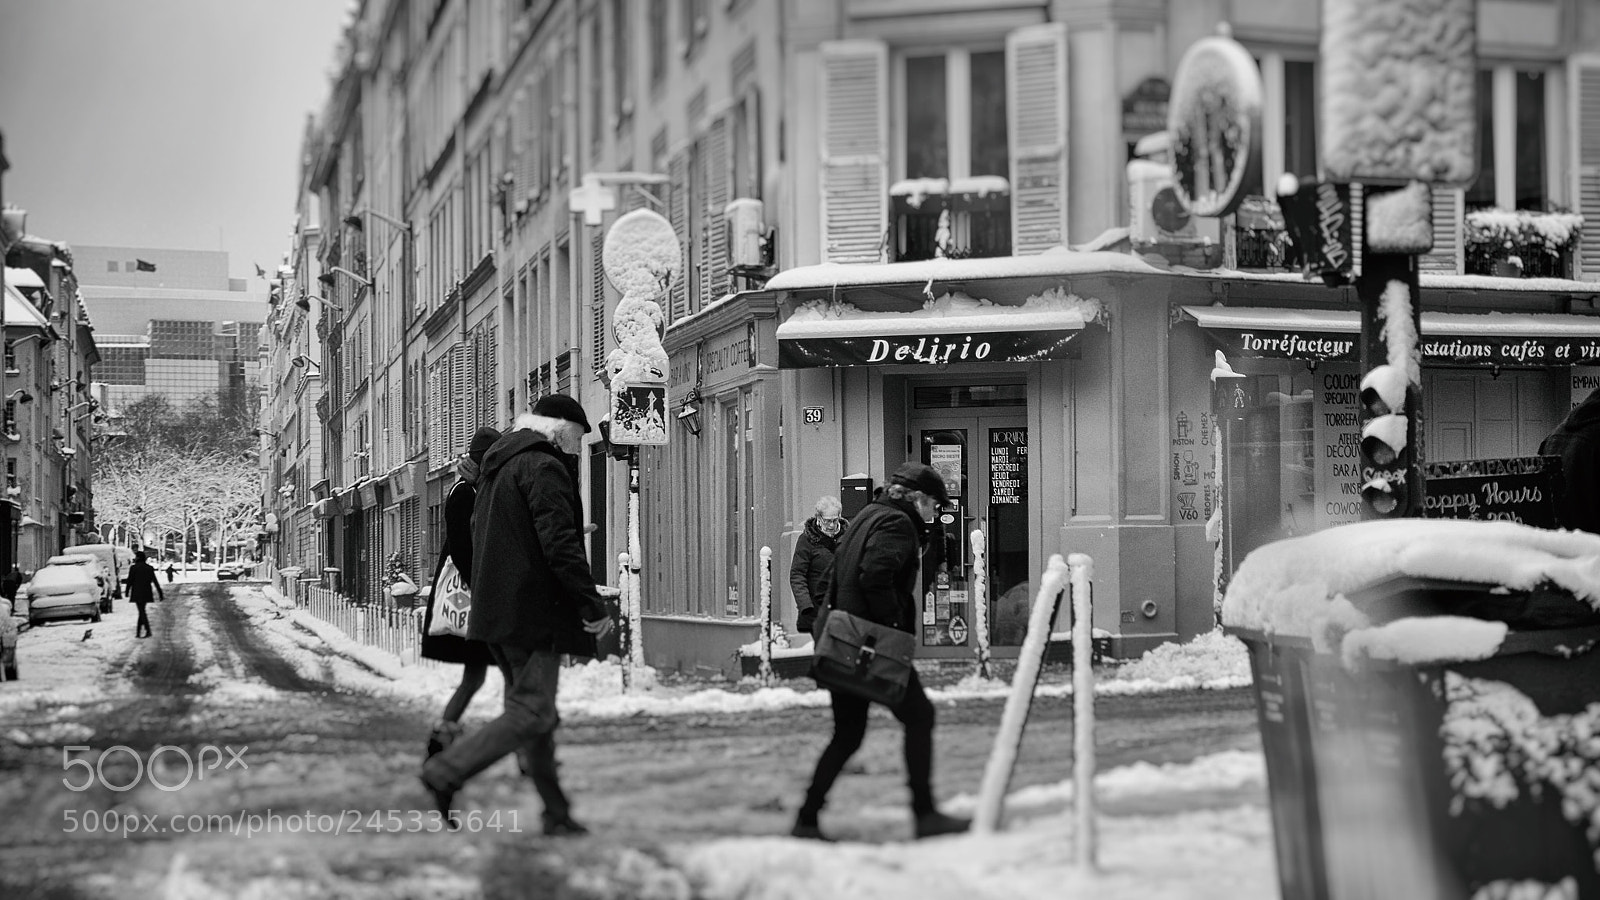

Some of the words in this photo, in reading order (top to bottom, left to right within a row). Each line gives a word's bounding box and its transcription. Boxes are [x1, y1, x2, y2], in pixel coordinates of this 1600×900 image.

[866, 335, 991, 362] Delirio
[1241, 333, 1354, 356] Torréfacteur
[1421, 339, 1491, 357] stations
[1500, 340, 1544, 362] cafés
[1554, 343, 1570, 358] et
[805, 409, 822, 423] 39
[1201, 412, 1209, 446] CHEMEX
[1172, 438, 1195, 446] PISTON
[991, 447, 1009, 456] LUNDI
[991, 455, 1009, 464] MARDI
[991, 463, 1019, 472] MERCREDI
[1173, 452, 1181, 481] SIPHON
[1333, 463, 1349, 476] BAR
[991, 471, 1010, 480] JEUDI
[992, 479, 1020, 488] VENDREDI
[1340, 482, 1356, 495] VINS
[993, 487, 1014, 496] SAMEDI
[991, 495, 1020, 504] DIMANCHE
[1425, 492, 1480, 515] appy
[1481, 481, 1542, 505] Hours
[1179, 510, 1198, 521] V60
